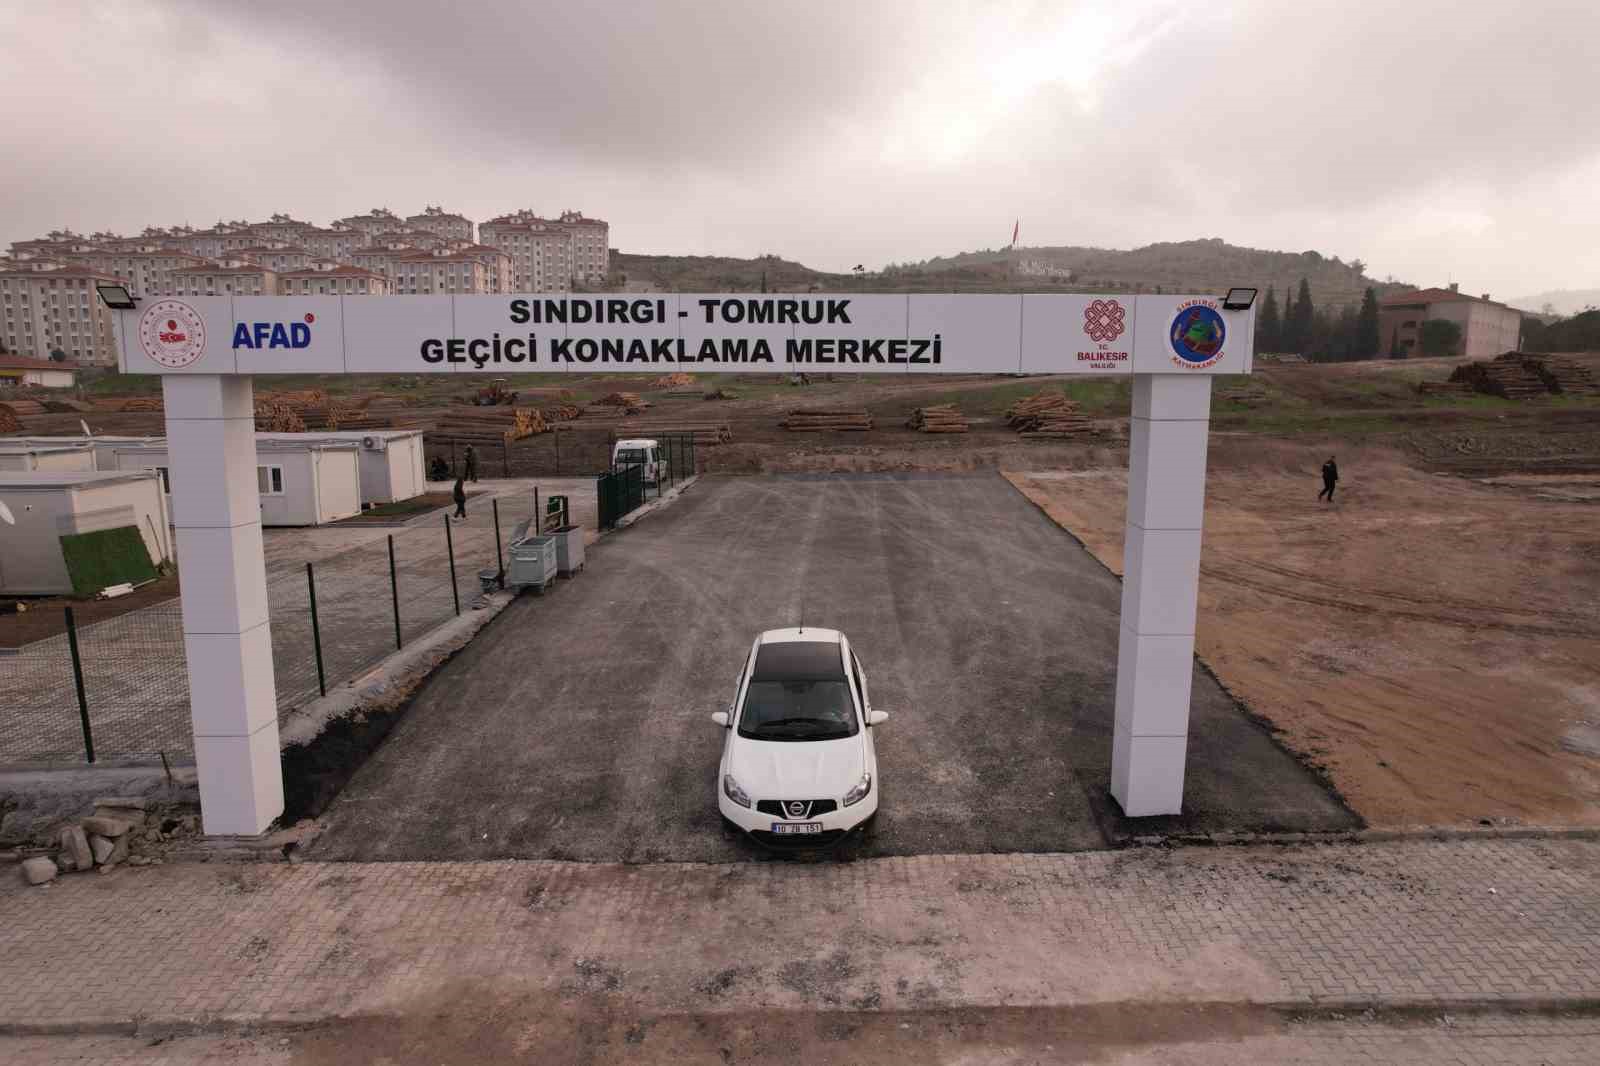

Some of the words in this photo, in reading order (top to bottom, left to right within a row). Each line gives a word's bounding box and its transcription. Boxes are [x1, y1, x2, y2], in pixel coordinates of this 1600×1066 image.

[510, 299, 665, 325] SINDIRGI
[698, 299, 851, 325] TOMRUK
[232, 322, 312, 349] AFAD
[420, 333, 537, 368] GEÇİCİ
[550, 338, 775, 363] KONAKLAMA
[786, 333, 942, 364] MERKEZİ
